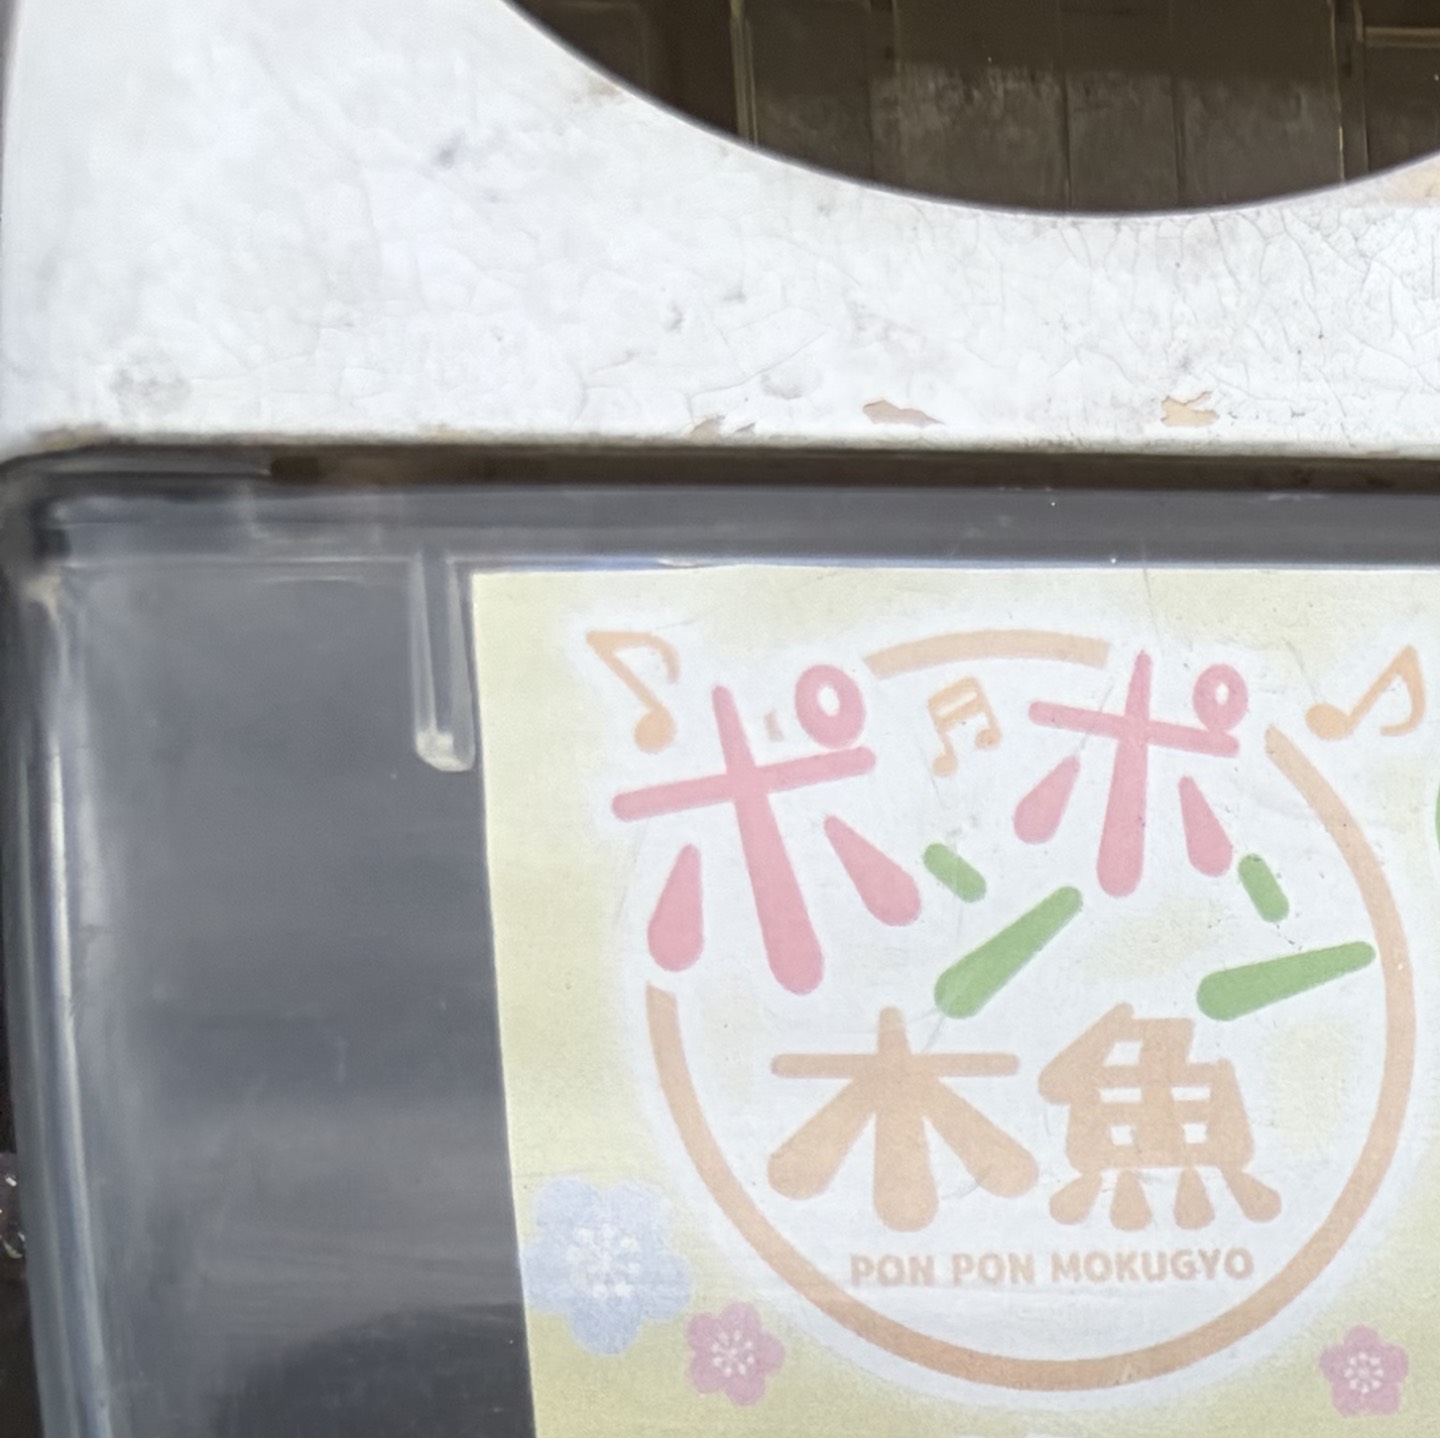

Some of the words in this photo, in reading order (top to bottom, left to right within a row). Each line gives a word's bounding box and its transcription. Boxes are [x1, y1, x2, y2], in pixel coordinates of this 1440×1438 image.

[612, 650, 1376, 1022] ポンポン
[767, 1004, 1283, 1232] 木魚
[850, 1253, 935, 1287] PON
[950, 1251, 1035, 1286] PON
[1051, 1247, 1254, 1284] MOKUGYO
